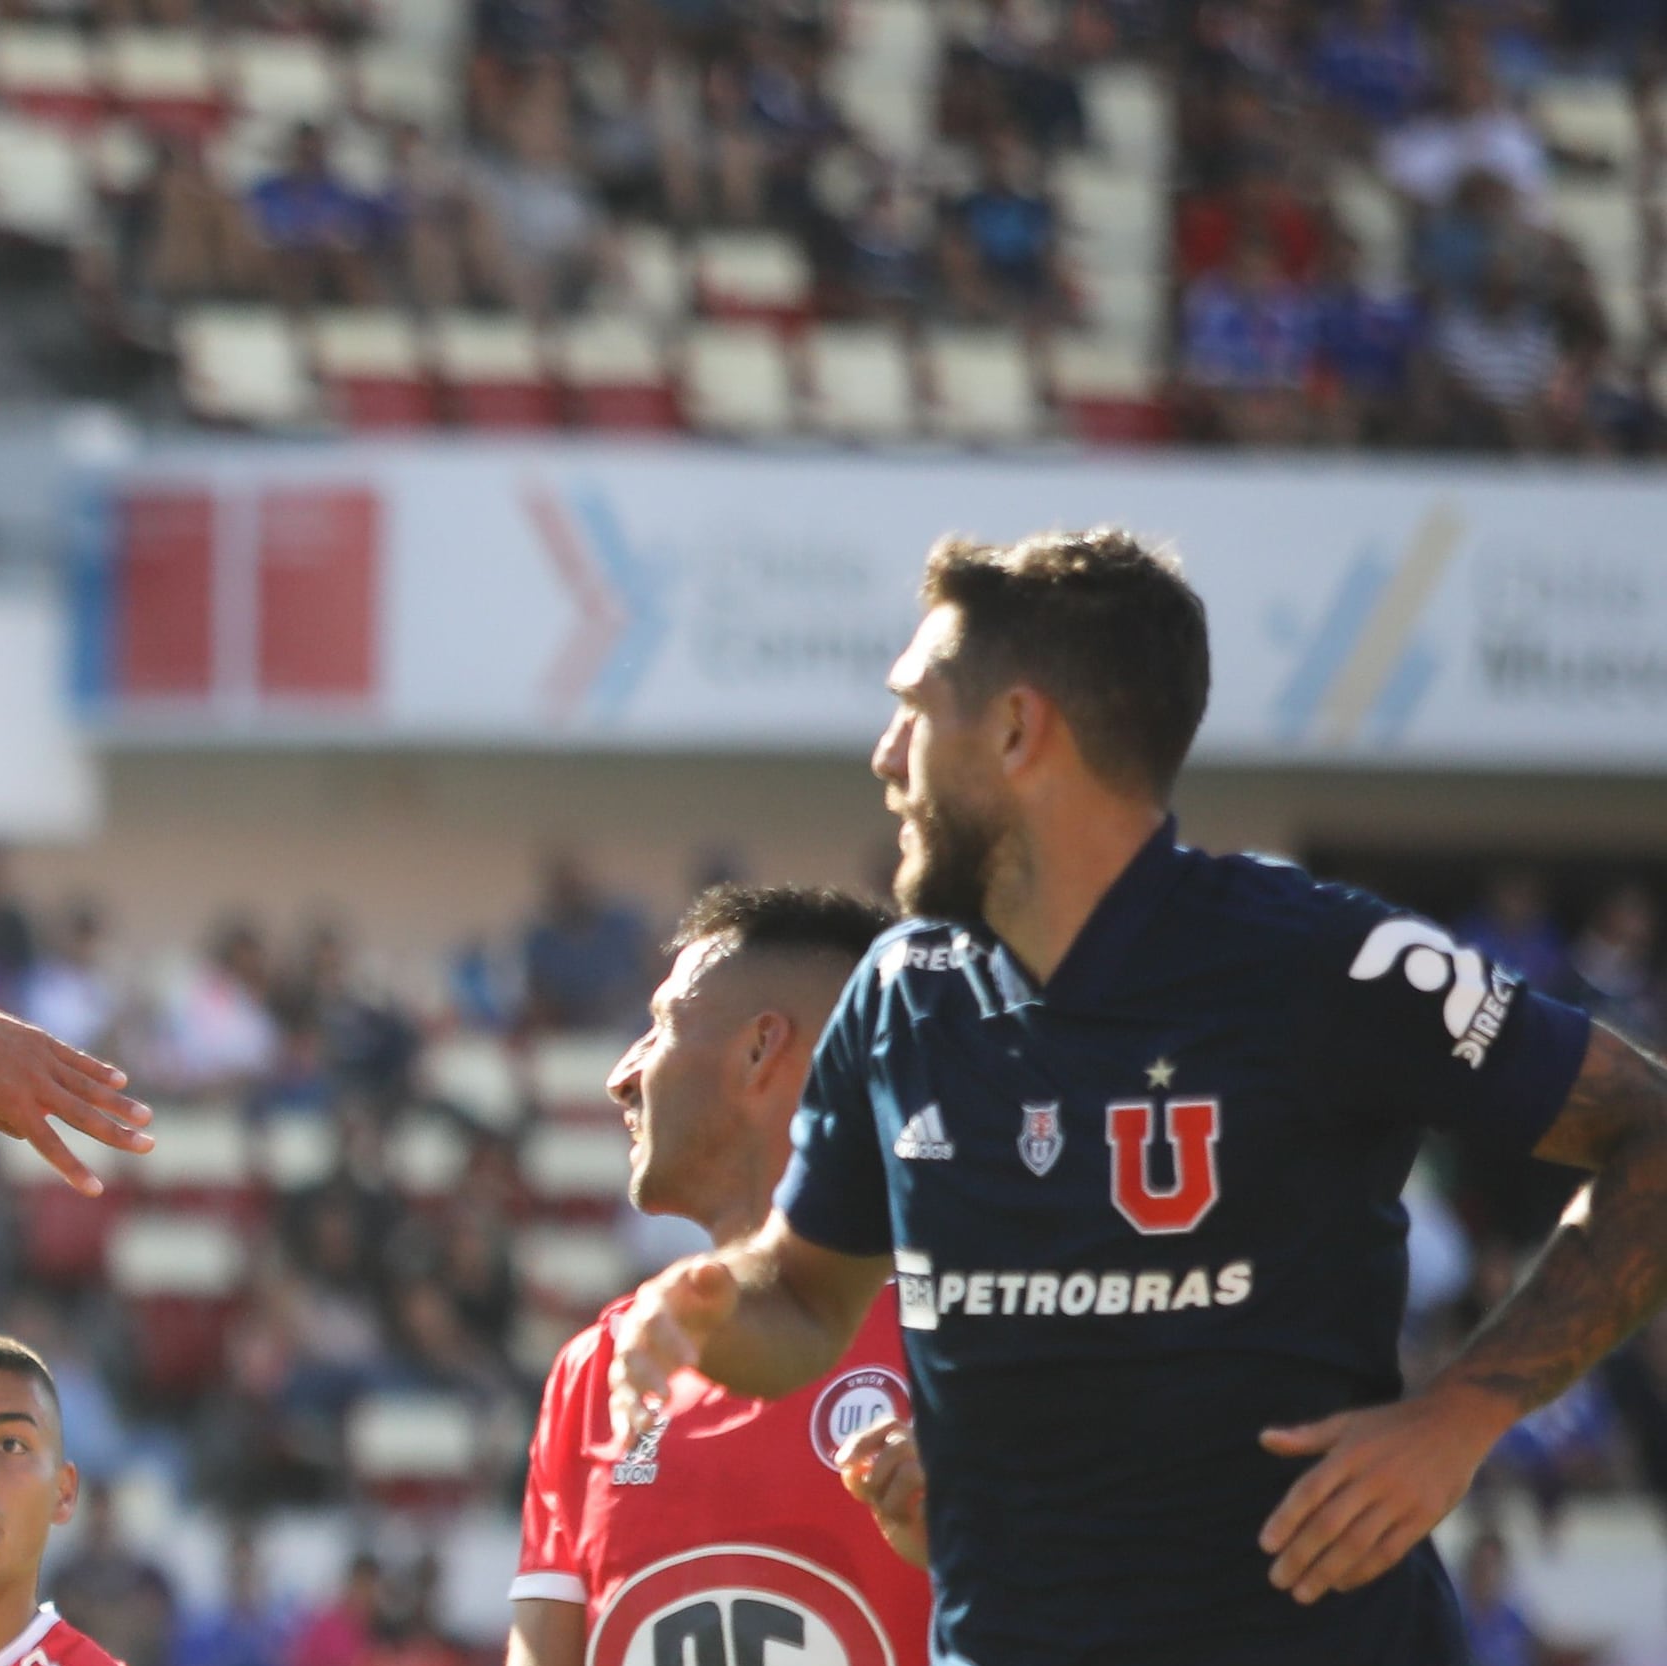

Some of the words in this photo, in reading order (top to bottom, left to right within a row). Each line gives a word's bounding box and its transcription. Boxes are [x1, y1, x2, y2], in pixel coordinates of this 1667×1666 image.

[1106, 1095, 1220, 1236] U
[938, 1261, 1253, 1316] PETROBRAS
[613, 1463, 657, 1484] LYON
